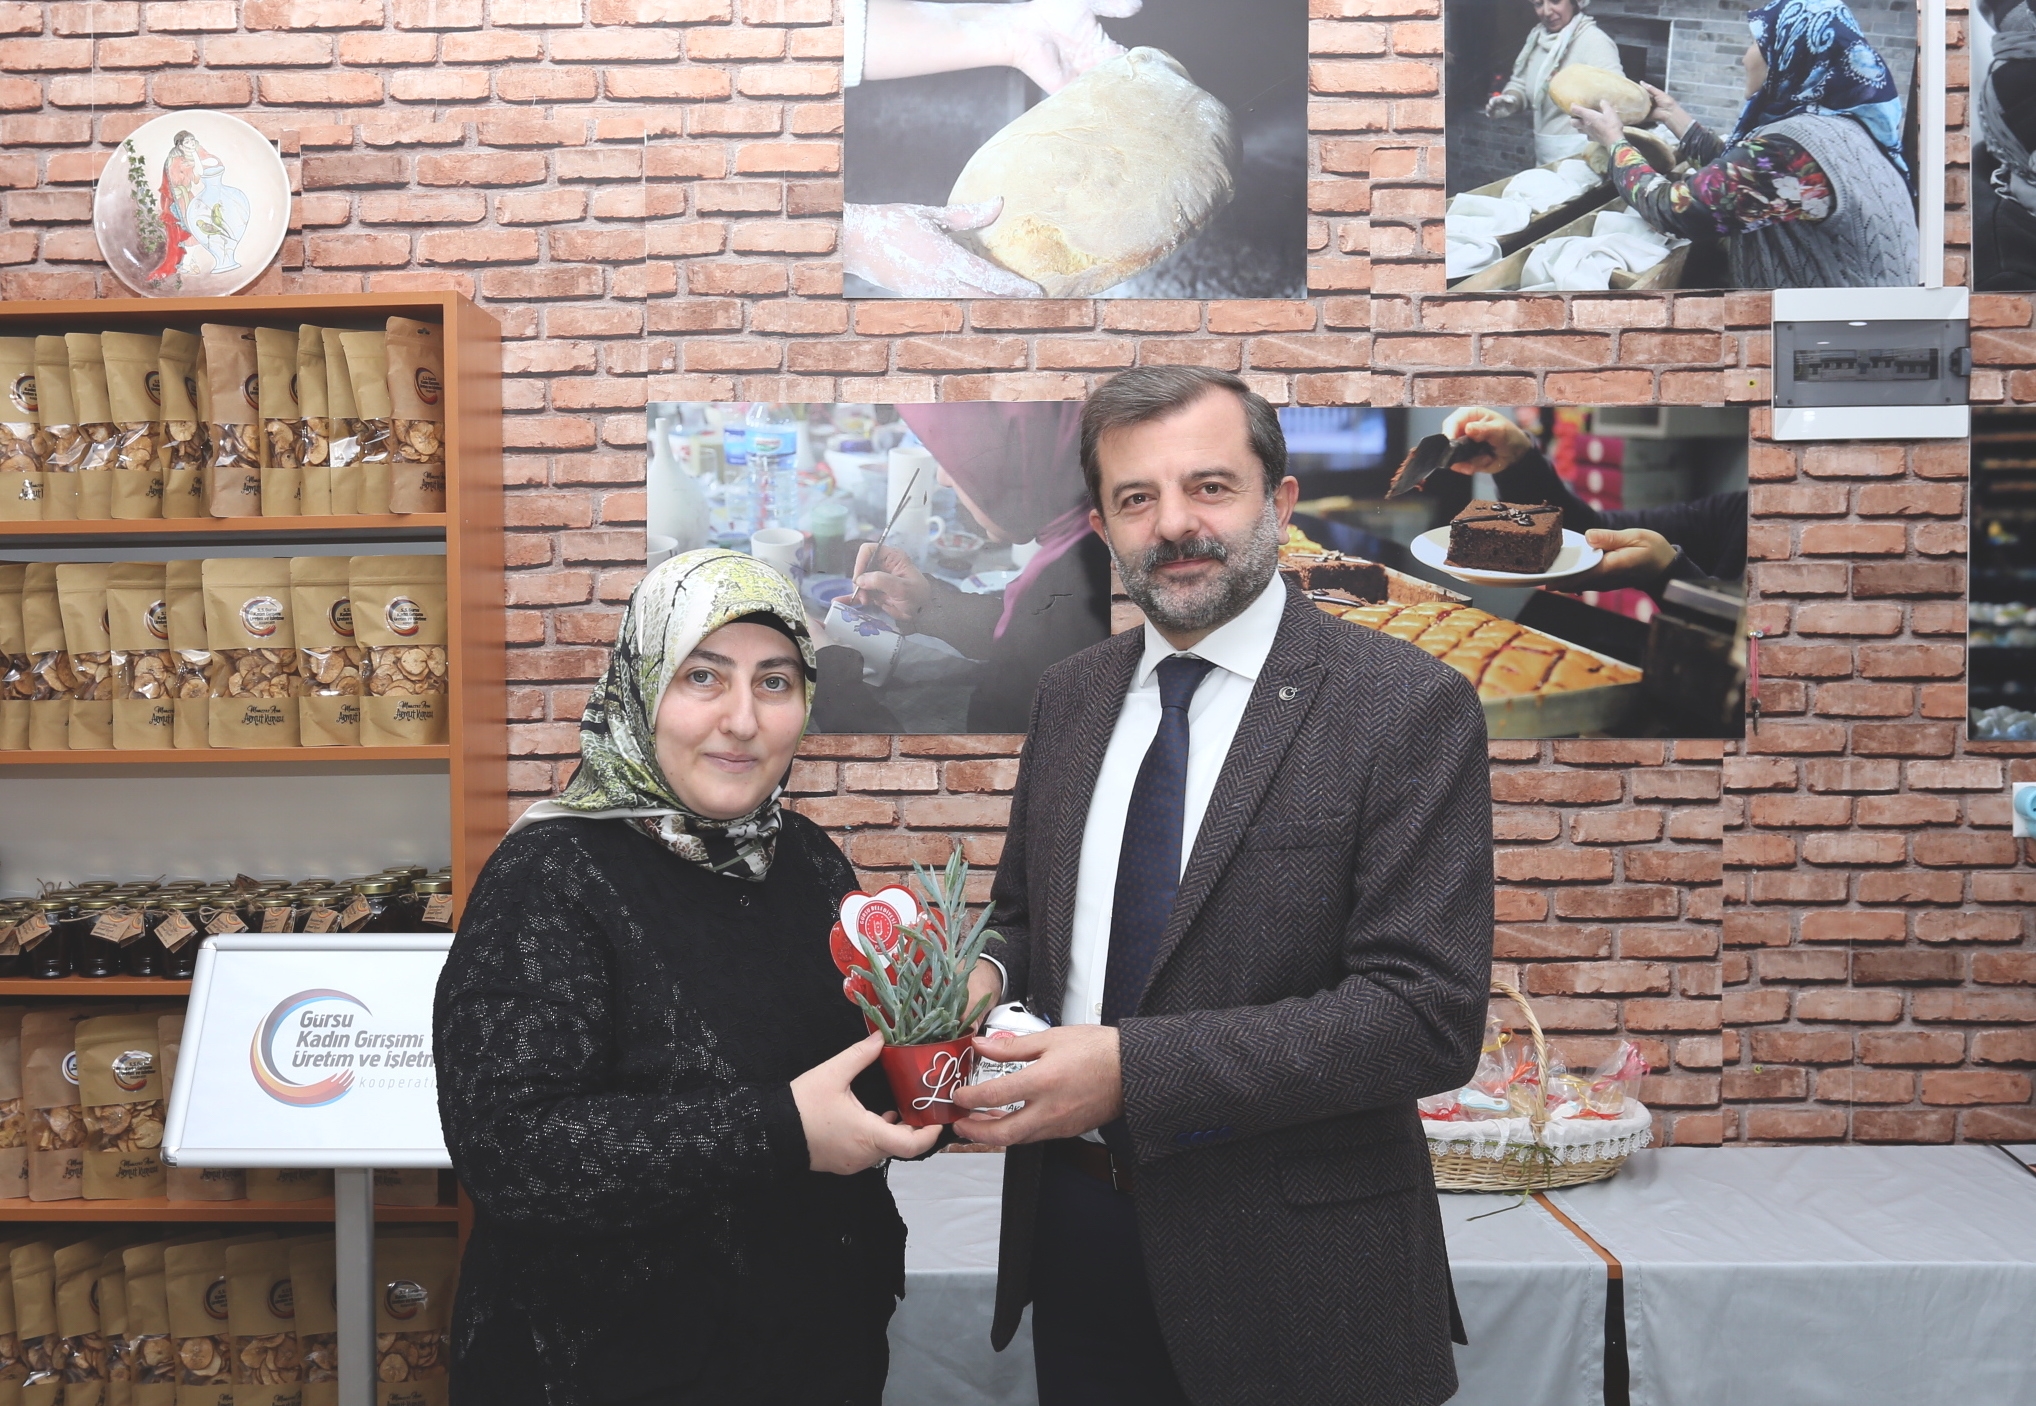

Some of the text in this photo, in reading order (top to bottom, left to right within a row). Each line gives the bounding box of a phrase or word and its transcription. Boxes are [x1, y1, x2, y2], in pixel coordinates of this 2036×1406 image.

[300, 1010, 354, 1028] Gürsu
[296, 1030, 424, 1049] Kadın Girişimi
[292, 1050, 354, 1068] Üretim
[359, 1054, 381, 1067] ve
